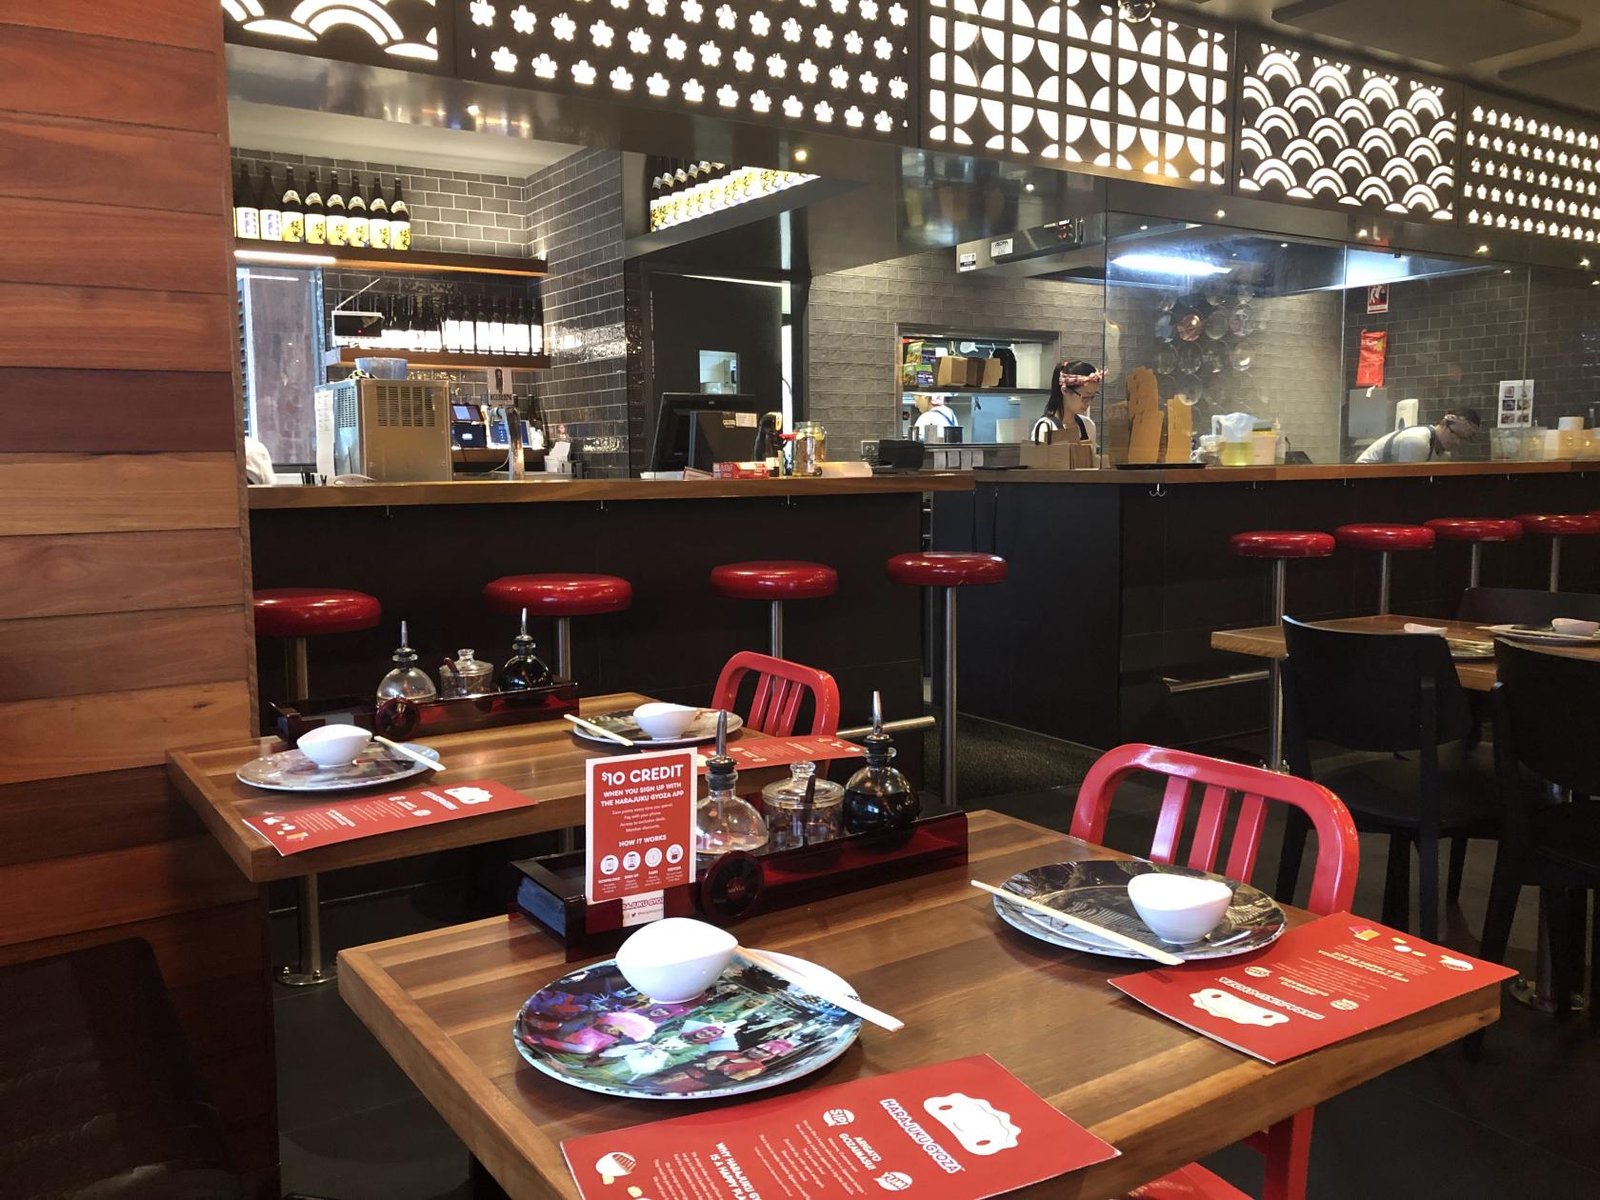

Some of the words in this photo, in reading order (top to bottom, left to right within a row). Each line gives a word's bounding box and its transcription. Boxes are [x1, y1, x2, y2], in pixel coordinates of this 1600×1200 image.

[602, 771, 626, 786] $10
[629, 764, 684, 783] CREDIT
[600, 799, 614, 807] THE
[614, 795, 650, 806] HARAJUKU
[650, 792, 671, 800] GYOZA
[672, 790, 685, 798] APP
[603, 789, 624, 798] WHEN
[625, 787, 639, 795] YOU
[640, 785, 655, 793] SIGN
[666, 782, 682, 790] WITH
[644, 834, 666, 843] WORKS
[828, 1109, 849, 1126] SIP!
[880, 1099, 934, 1146] HARAJUKU
[923, 1142, 961, 1174] GYOZA
[839, 1133, 877, 1170] GOZAIMASU!
[854, 1137, 882, 1162] ARIGATO
[709, 1153, 717, 1163] IS
[715, 1160, 722, 1168] A
[719, 1166, 741, 1192] HAPPY
[716, 1142, 731, 1158] WHY
[725, 1155, 754, 1196] HARAJUKU
[881, 1172, 909, 1190] YUM!
